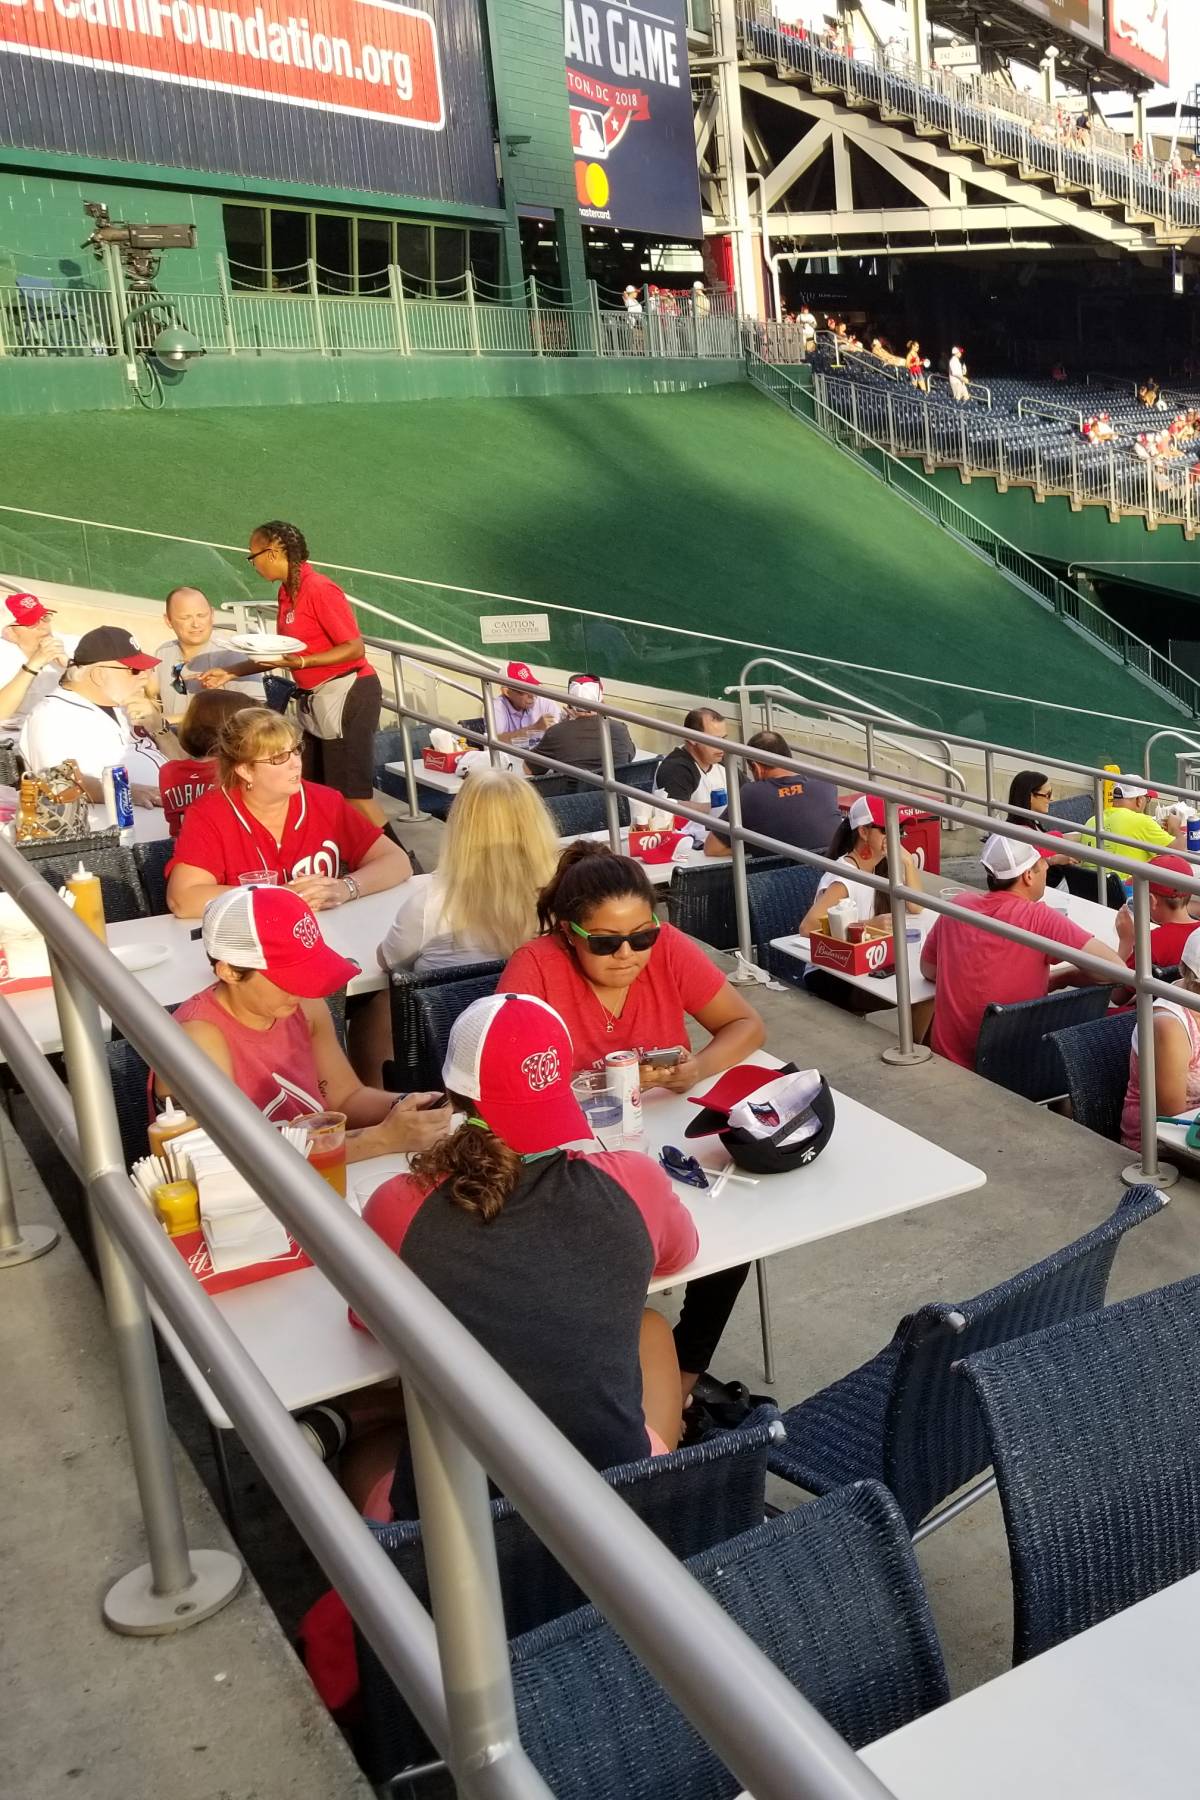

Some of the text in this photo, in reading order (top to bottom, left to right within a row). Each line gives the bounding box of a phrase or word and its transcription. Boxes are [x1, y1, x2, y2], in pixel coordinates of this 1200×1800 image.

[0, 0, 413, 101] eamFoundation.org
[606, 9, 680, 88] GAME
[596, 87, 609, 102] DC
[615, 92, 638, 107] 2018
[494, 620, 536, 629] CAUTION
[817, 941, 888, 970] Budweiser W
